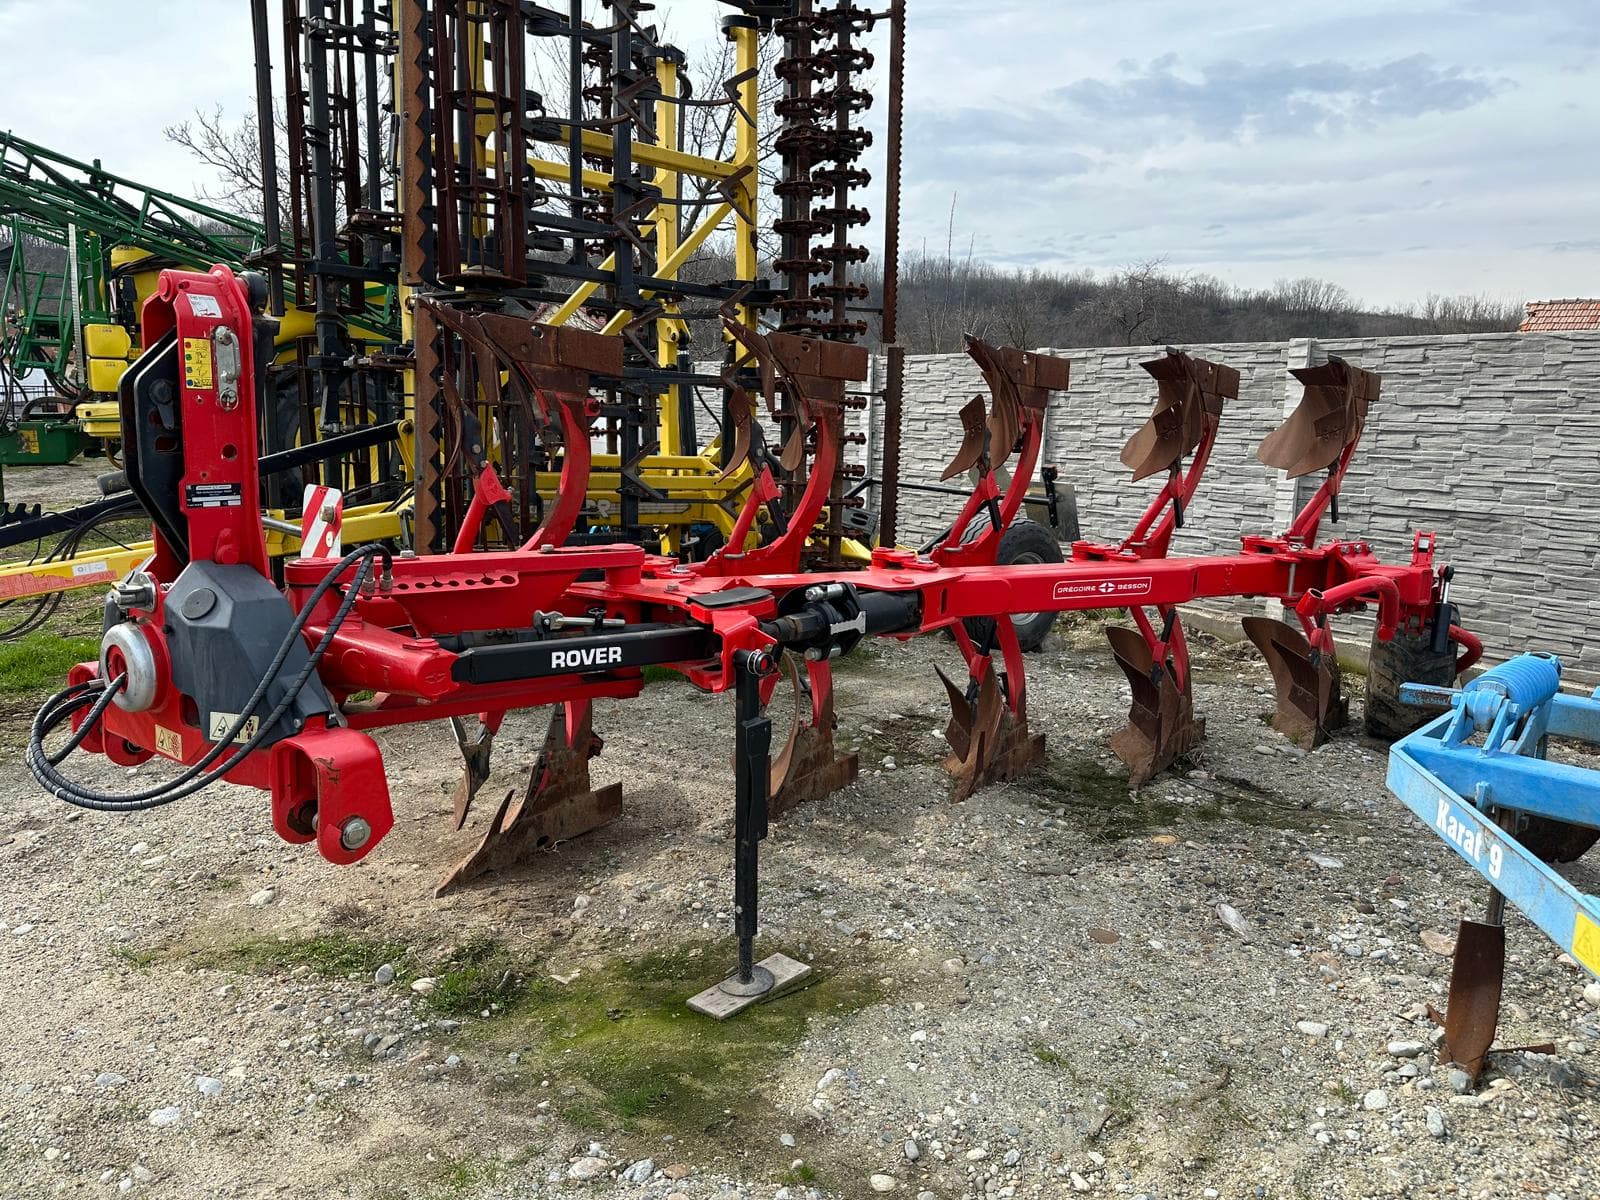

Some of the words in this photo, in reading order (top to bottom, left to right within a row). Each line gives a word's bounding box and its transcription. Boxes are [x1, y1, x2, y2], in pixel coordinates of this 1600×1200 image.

[551, 646, 622, 669] ROVER
[1435, 798, 1483, 864] Karat
[1488, 843, 1503, 880] 9
